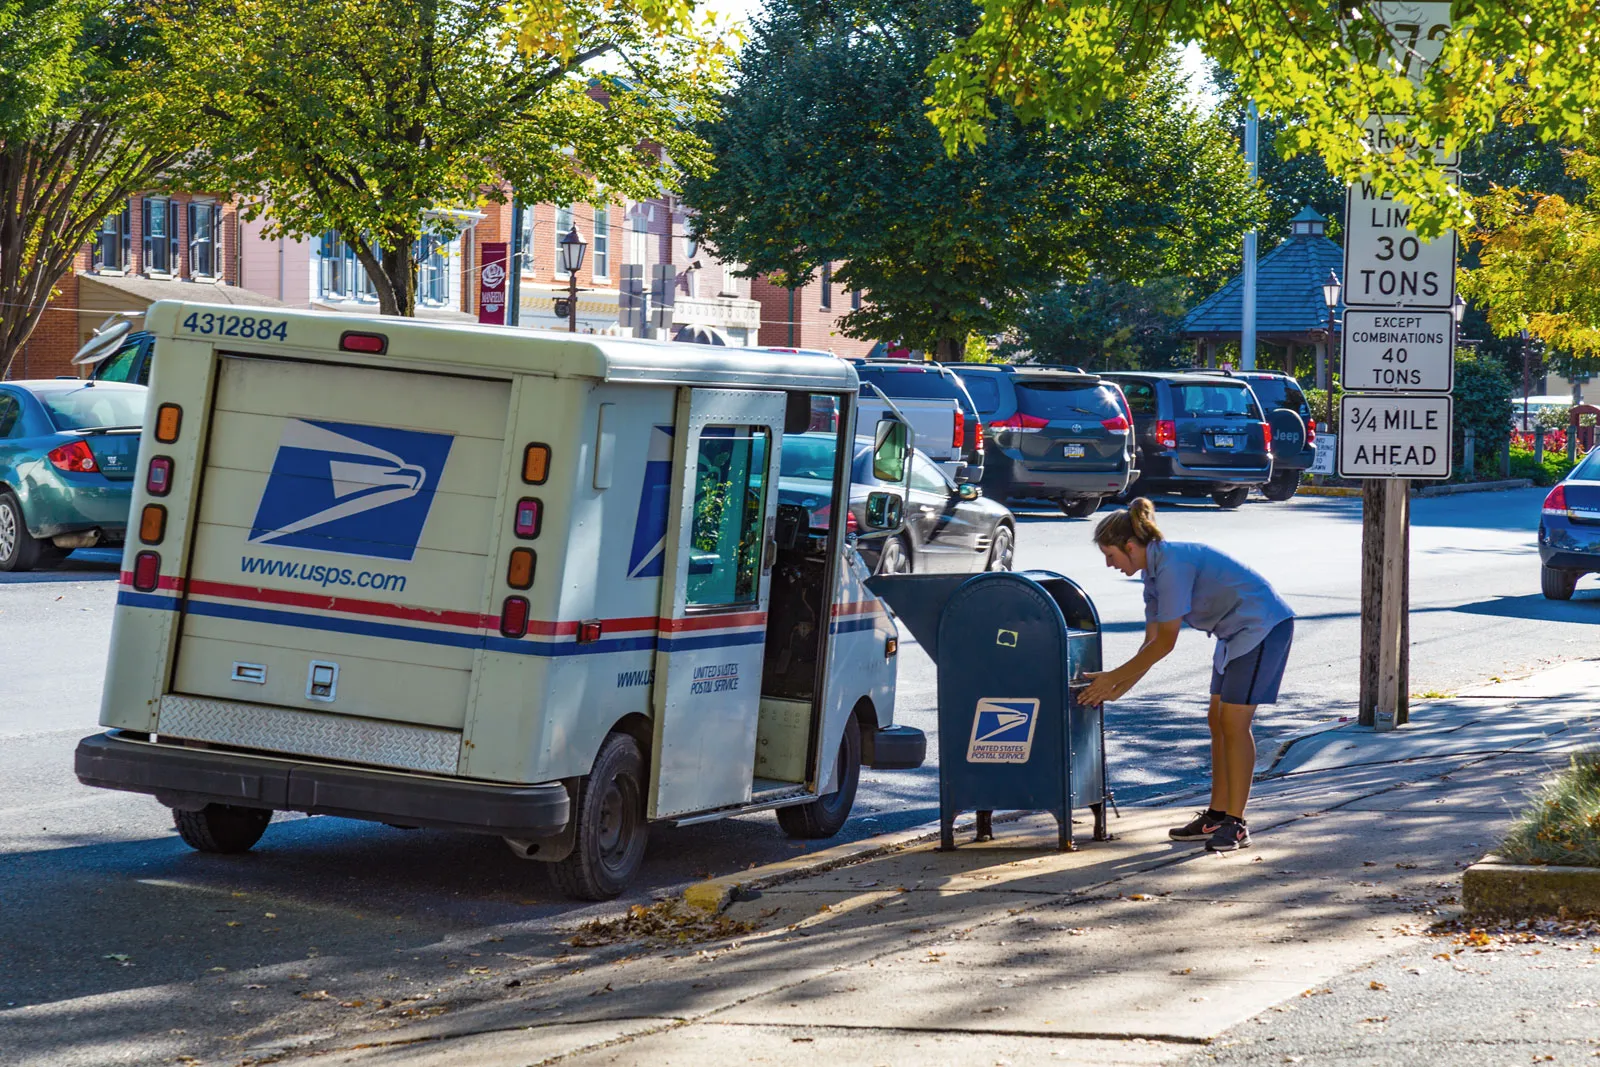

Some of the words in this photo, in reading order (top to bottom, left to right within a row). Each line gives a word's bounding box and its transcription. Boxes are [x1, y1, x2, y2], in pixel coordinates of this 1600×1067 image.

[1375, 236, 1419, 261] 30
[1360, 269, 1438, 296] TONS
[183, 312, 289, 342] 4312884
[1374, 317, 1422, 328] EXCEPT
[1352, 331, 1444, 344] COMBINATIONS
[1381, 347, 1408, 364] 40
[1372, 368, 1421, 385] TONS
[1384, 410, 1438, 430] MILE
[1273, 429, 1300, 443] Jeep
[1353, 445, 1437, 466] AHEAD
[241, 556, 407, 592] www.usps.com
[693, 664, 717, 680] UNITED
[716, 662, 740, 677] STATES
[690, 680, 713, 695] POSTAL
[714, 677, 740, 692] SERVICE
